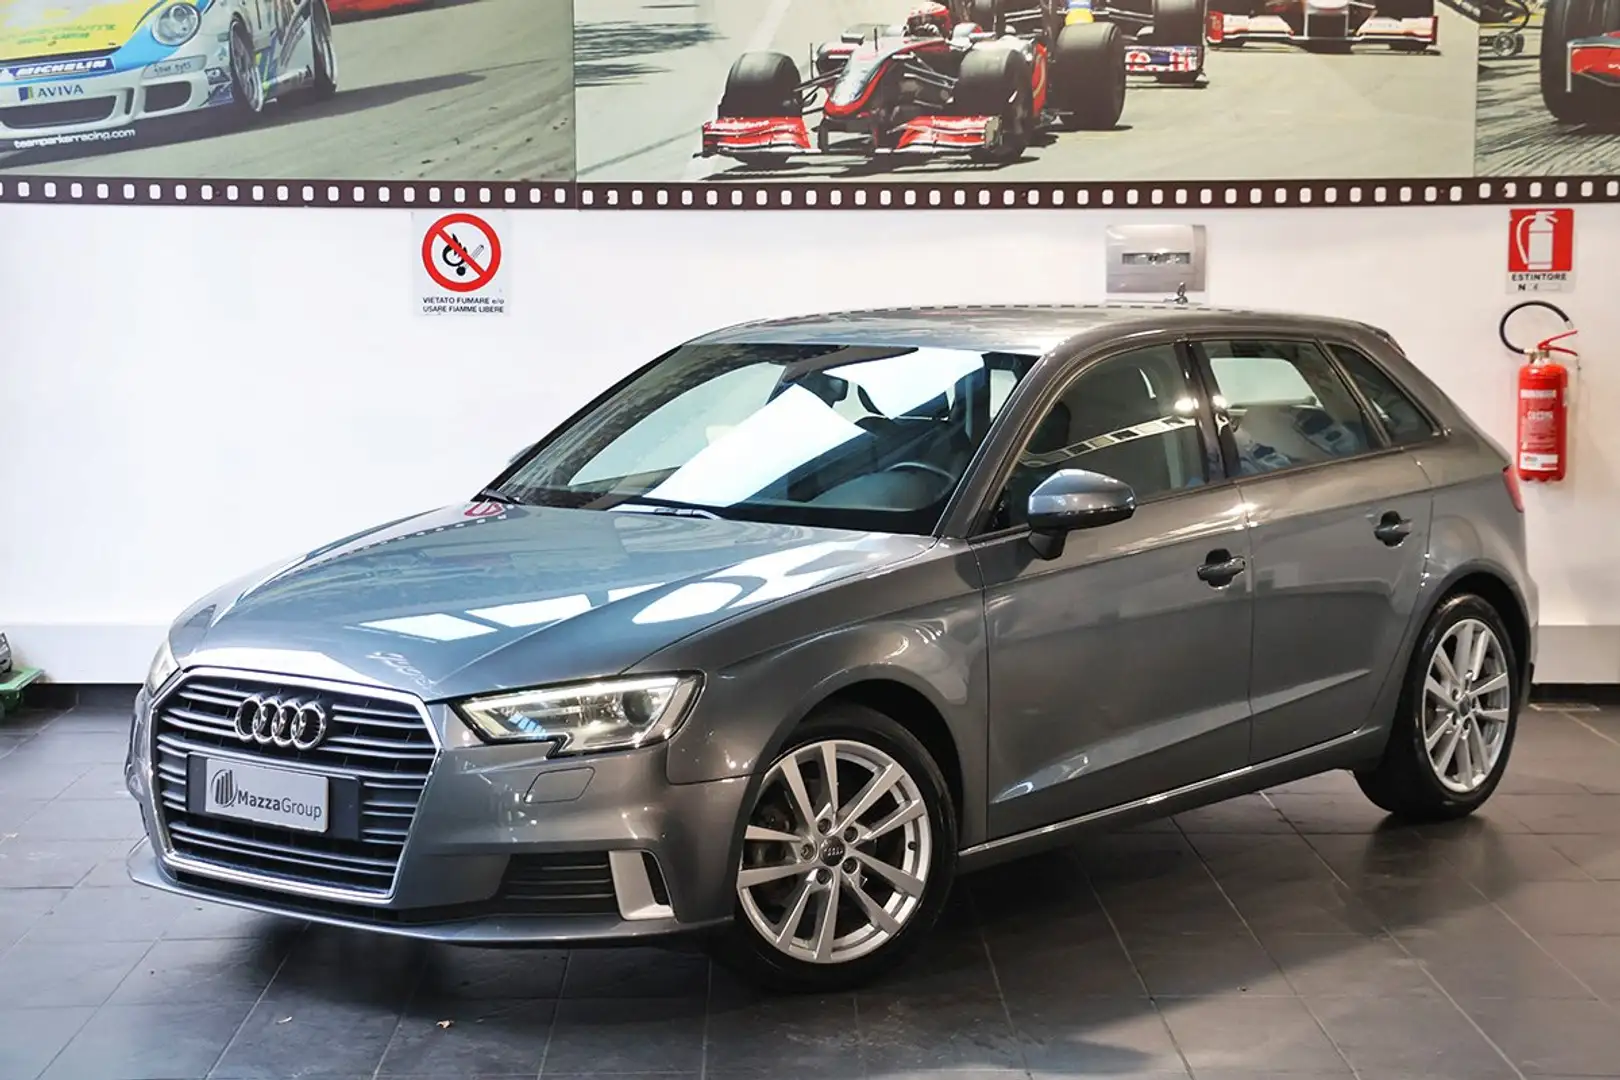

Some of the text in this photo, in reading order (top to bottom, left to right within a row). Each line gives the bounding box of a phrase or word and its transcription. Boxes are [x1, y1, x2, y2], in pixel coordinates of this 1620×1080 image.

[16, 60, 107, 76] MICHELIN
[38, 85, 84, 98] AVIVA
[13, 128, 136, 149] teamparkerracing.com
[1511, 273, 1567, 281] ESTINTORE
[237, 789, 323, 820] MazzaGroup
